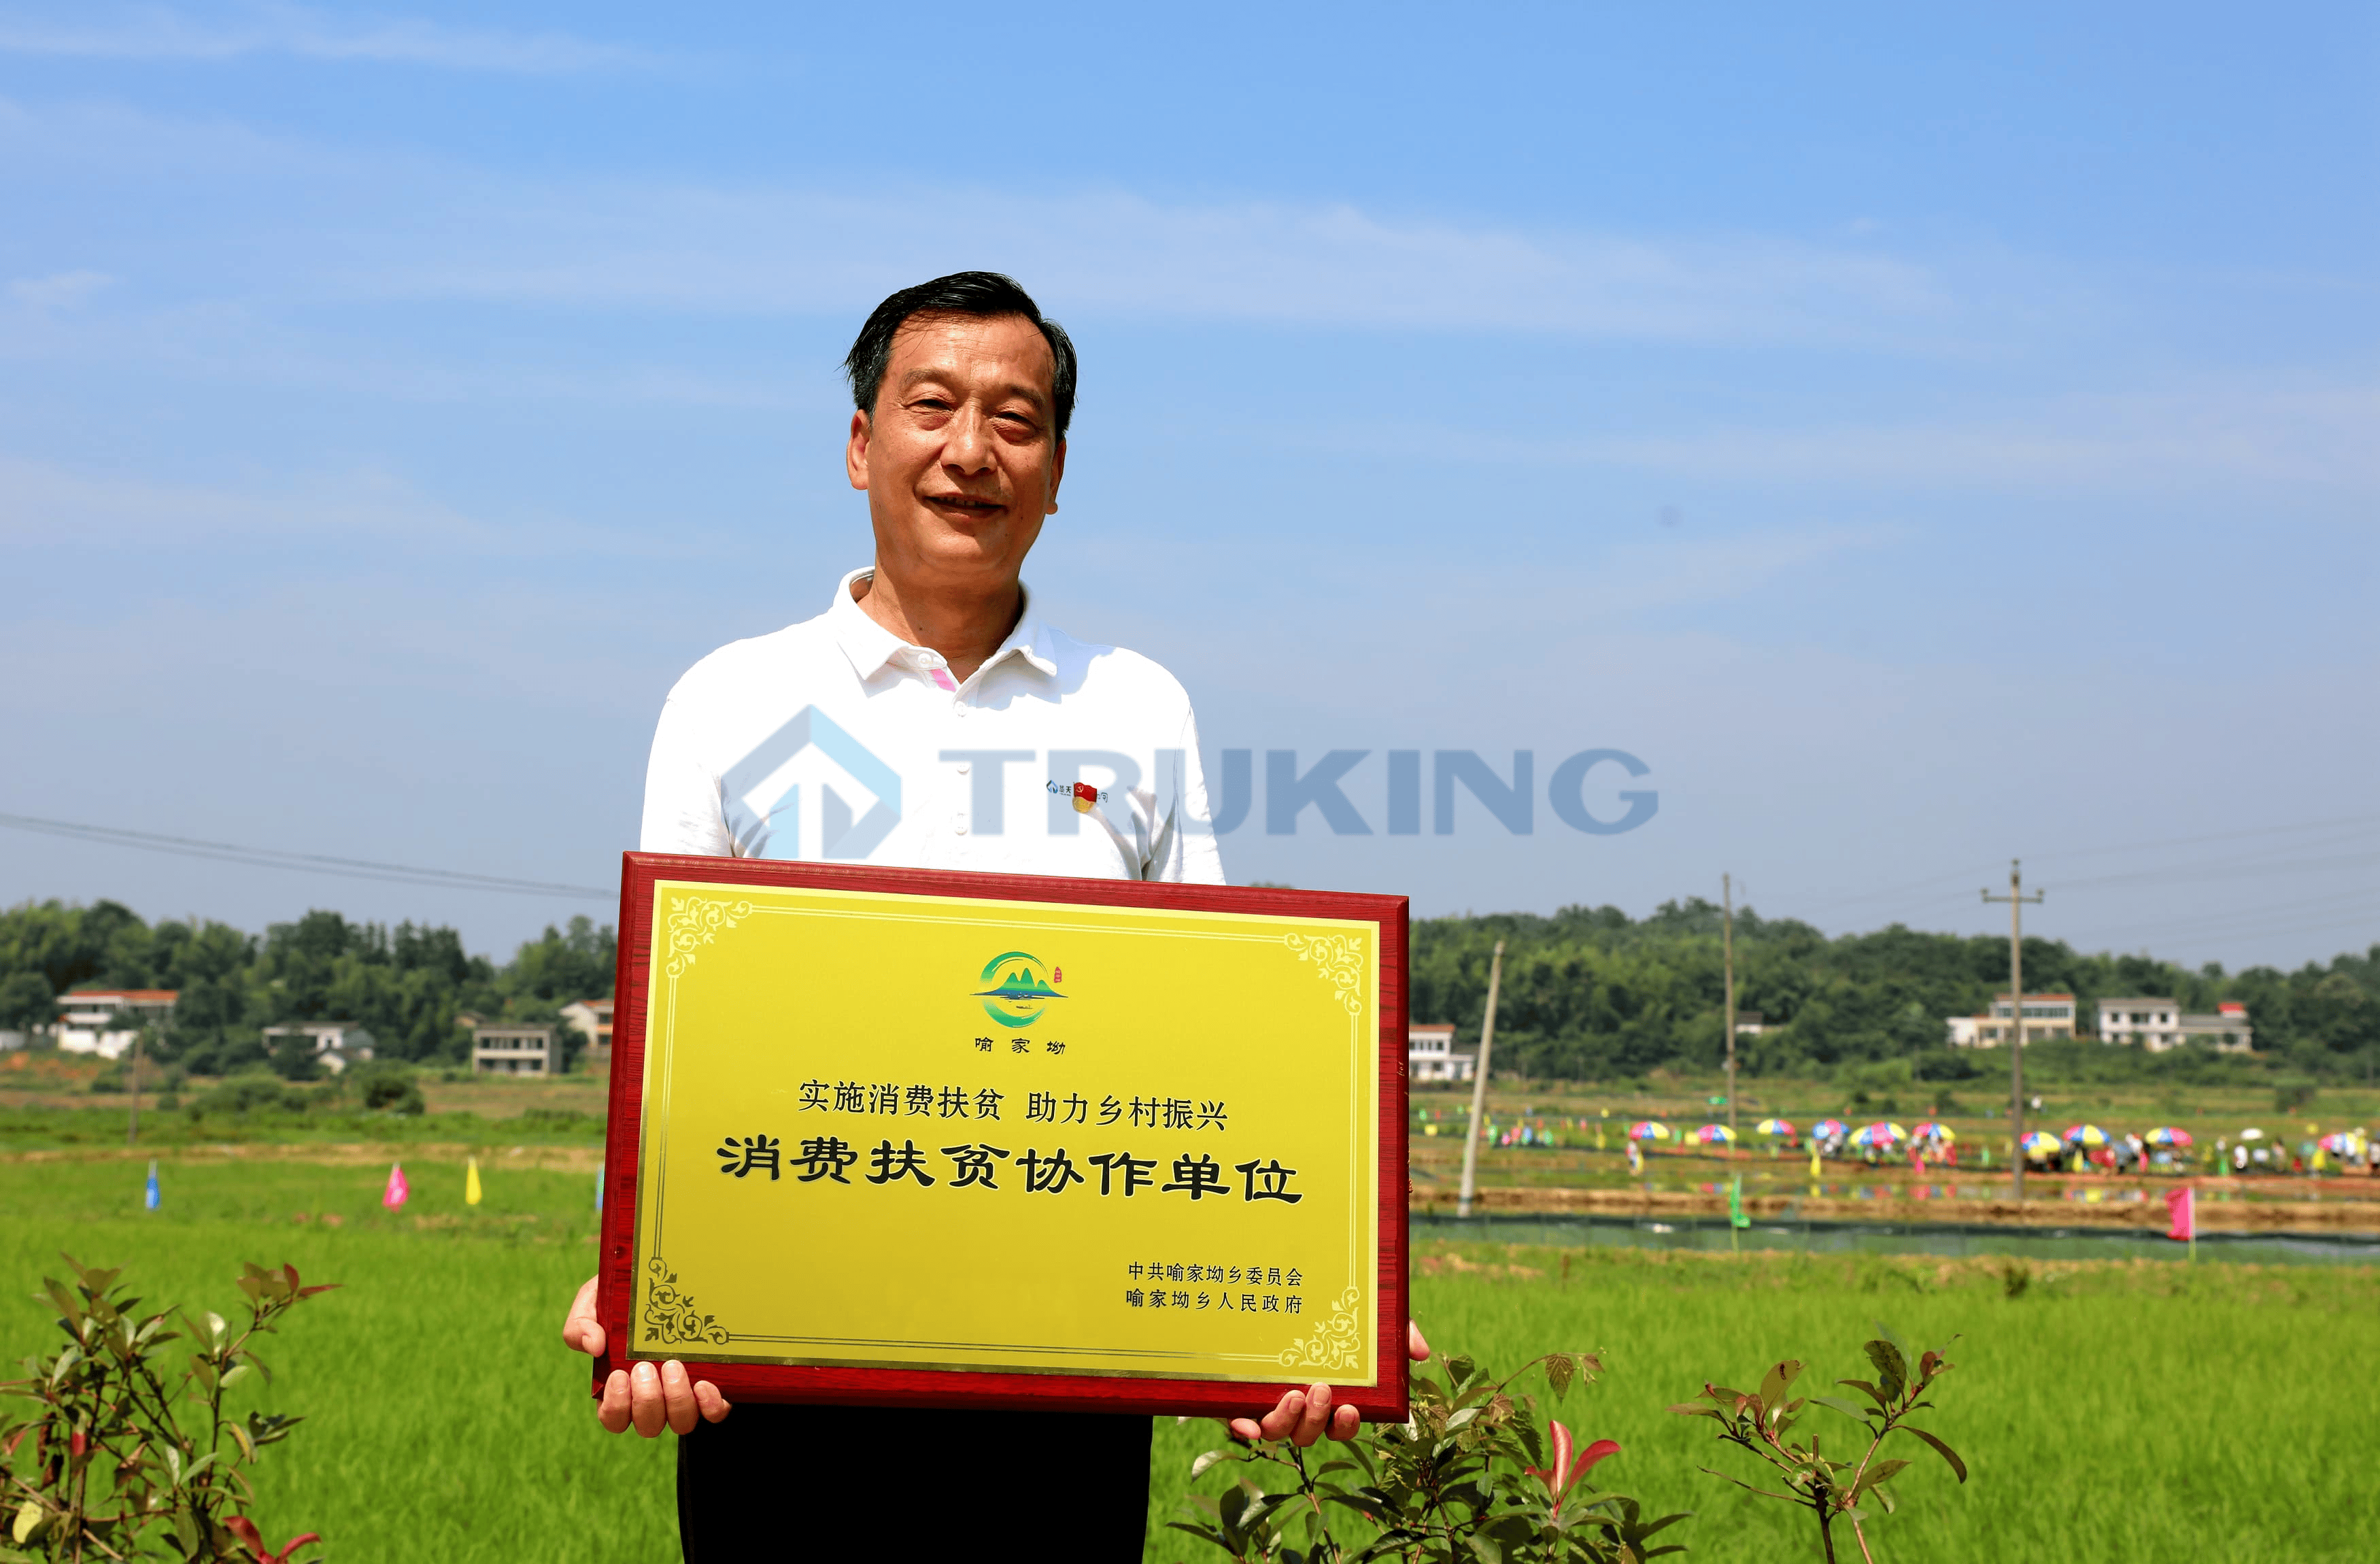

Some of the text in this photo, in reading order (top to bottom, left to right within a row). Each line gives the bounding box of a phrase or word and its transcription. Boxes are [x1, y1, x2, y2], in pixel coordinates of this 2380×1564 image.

[975, 1037, 1065, 1055] 喻家坳
[799, 1080, 1227, 1130] 实施消费扶贫 助力乡村振兴
[717, 1134, 1302, 1203] 消费扶贫协作单位
[1129, 1261, 1302, 1286] 中共喻家坳乡委员会
[1127, 1289, 1302, 1314] 喻家坳乡人民政府
